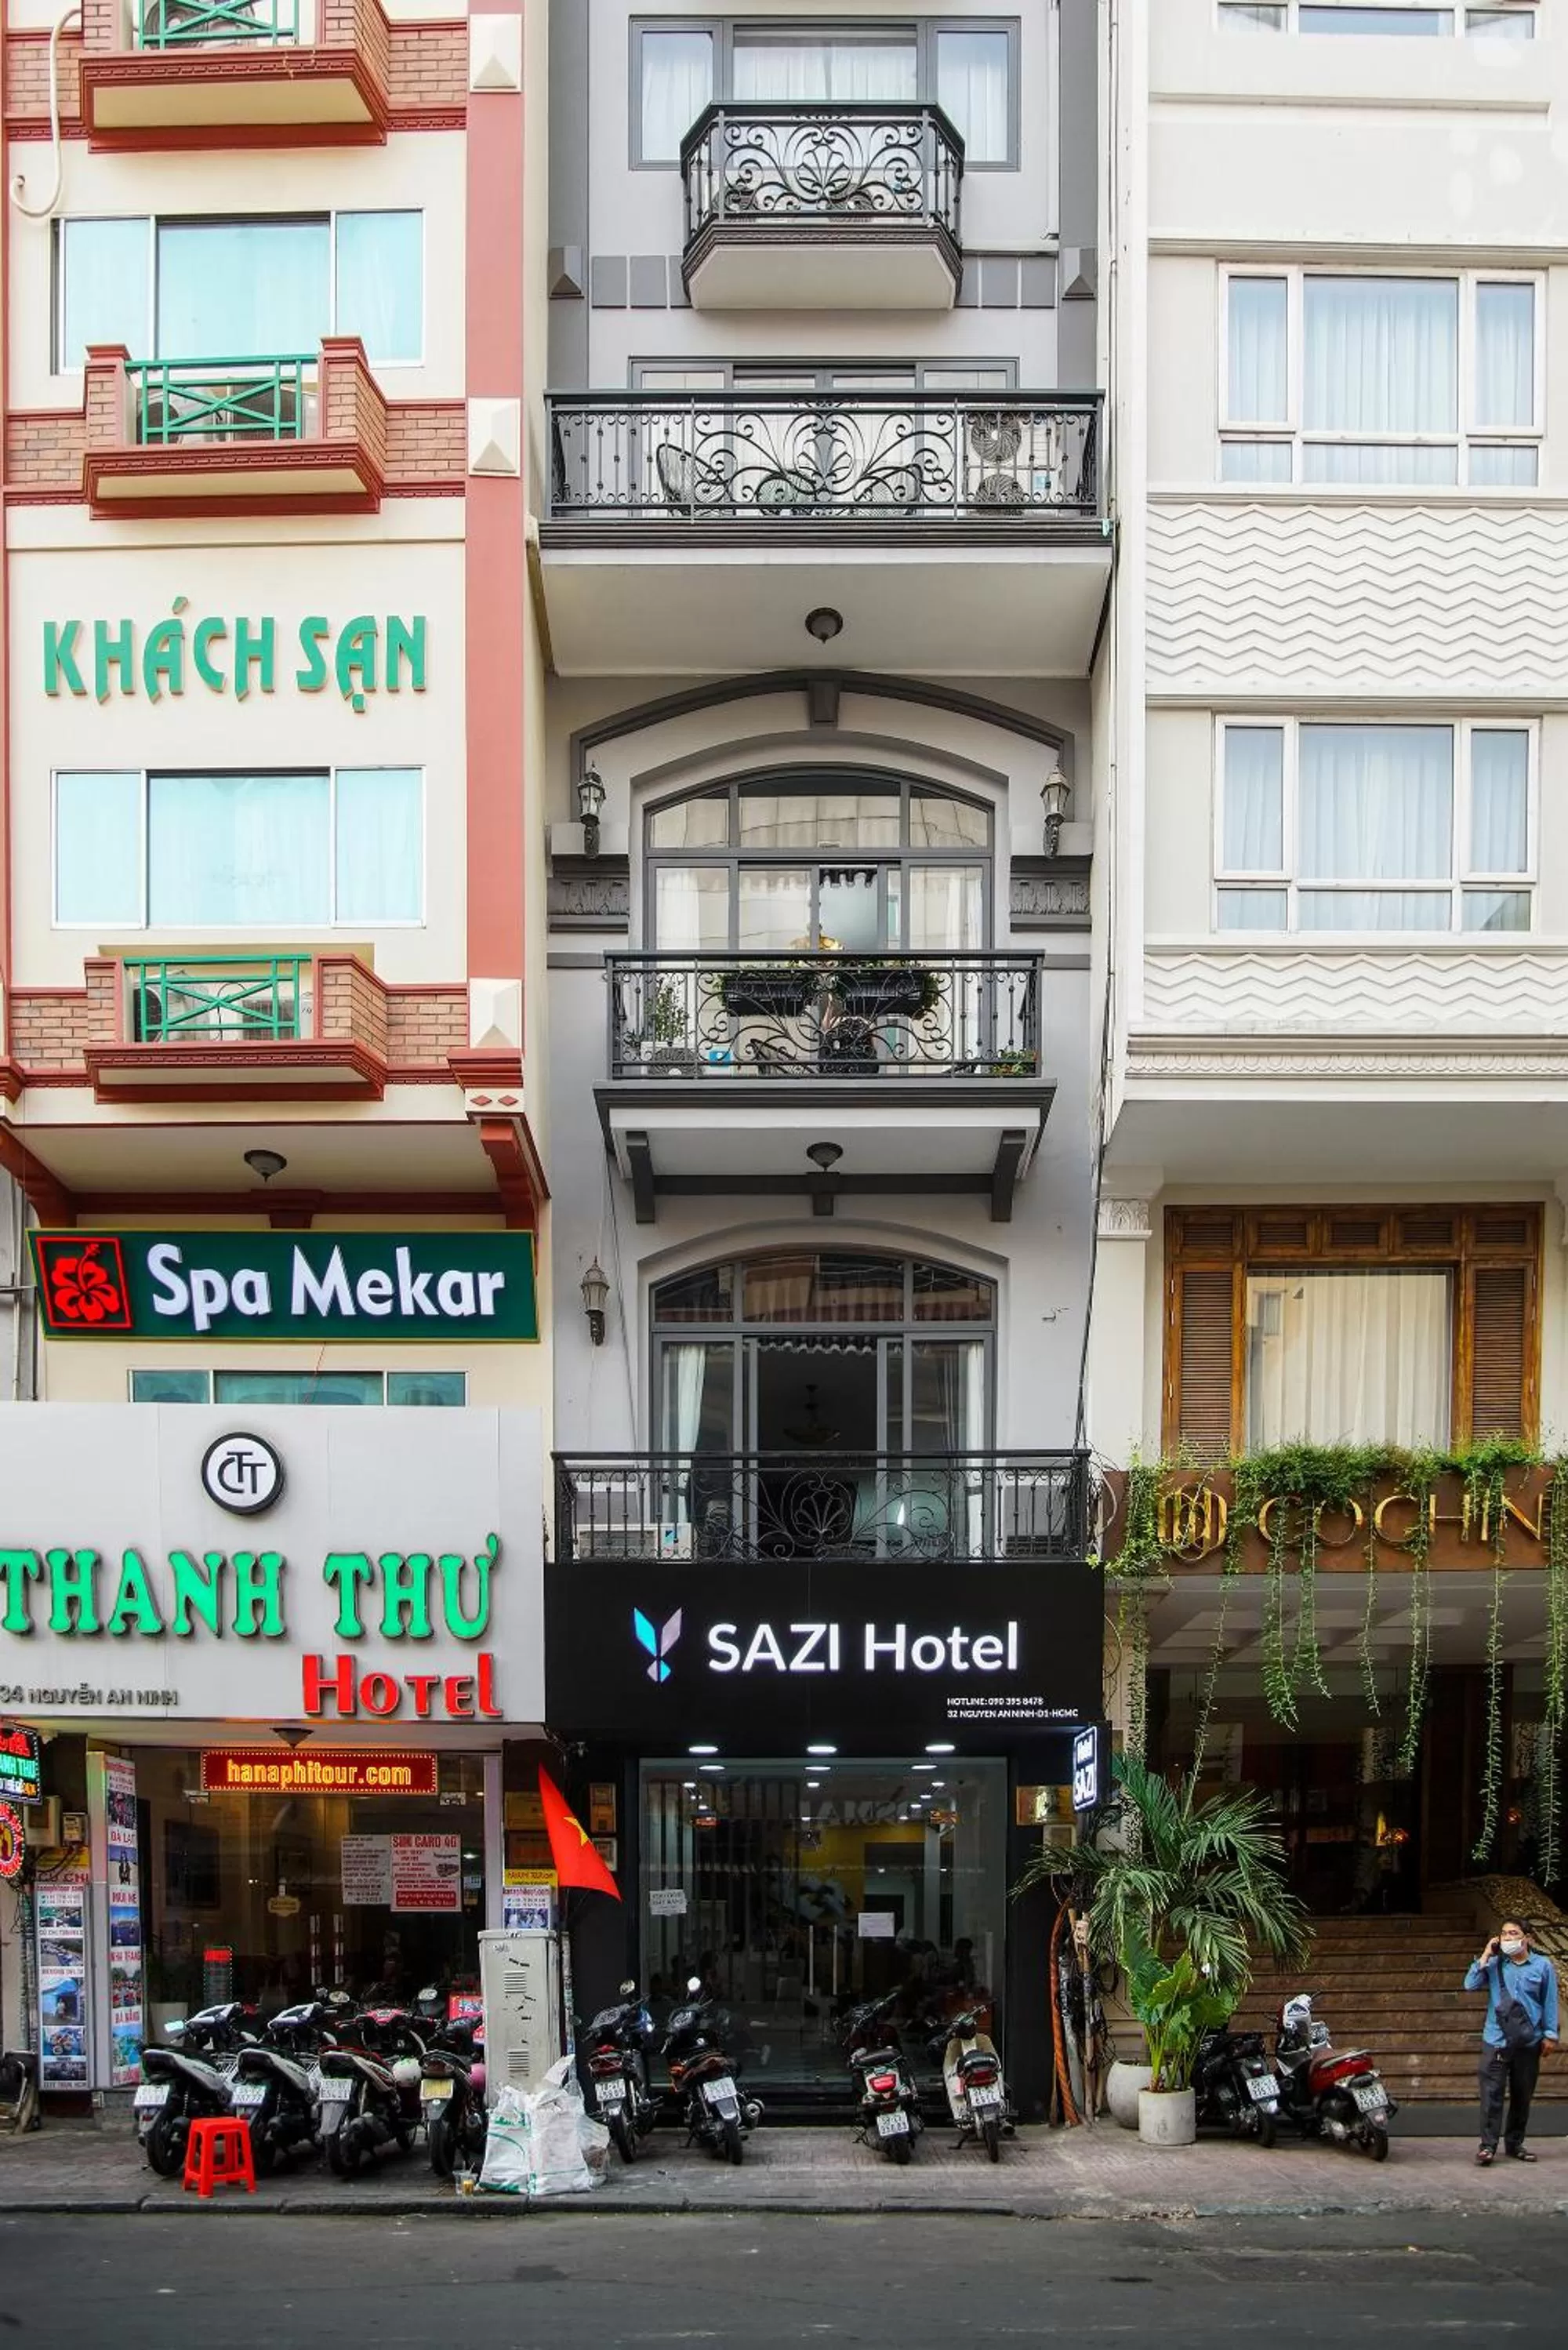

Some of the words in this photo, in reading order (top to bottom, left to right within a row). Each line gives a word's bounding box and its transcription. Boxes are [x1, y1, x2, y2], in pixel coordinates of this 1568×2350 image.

[43, 596, 275, 704] KHÁCH
[296, 616, 426, 713] SẠN
[147, 1244, 273, 1331] Spa
[291, 1244, 505, 1317] Mekar
[0, 1549, 286, 1637] THANH
[323, 1532, 500, 1639] THƯ
[707, 1623, 840, 1672] SAZI
[865, 1621, 1018, 1672] Hotel
[0, 1685, 24, 1704] 34
[28, 1682, 102, 1705] NGUYỄN
[107, 1689, 132, 1705] AN
[137, 1689, 179, 1705] NINH
[947, 1697, 987, 1705] HOTLINE:
[997, 1709, 1011, 1718] AN
[227, 1759, 412, 1788] hanaphitour.com
[1075, 1763, 1094, 1803] SAZI
